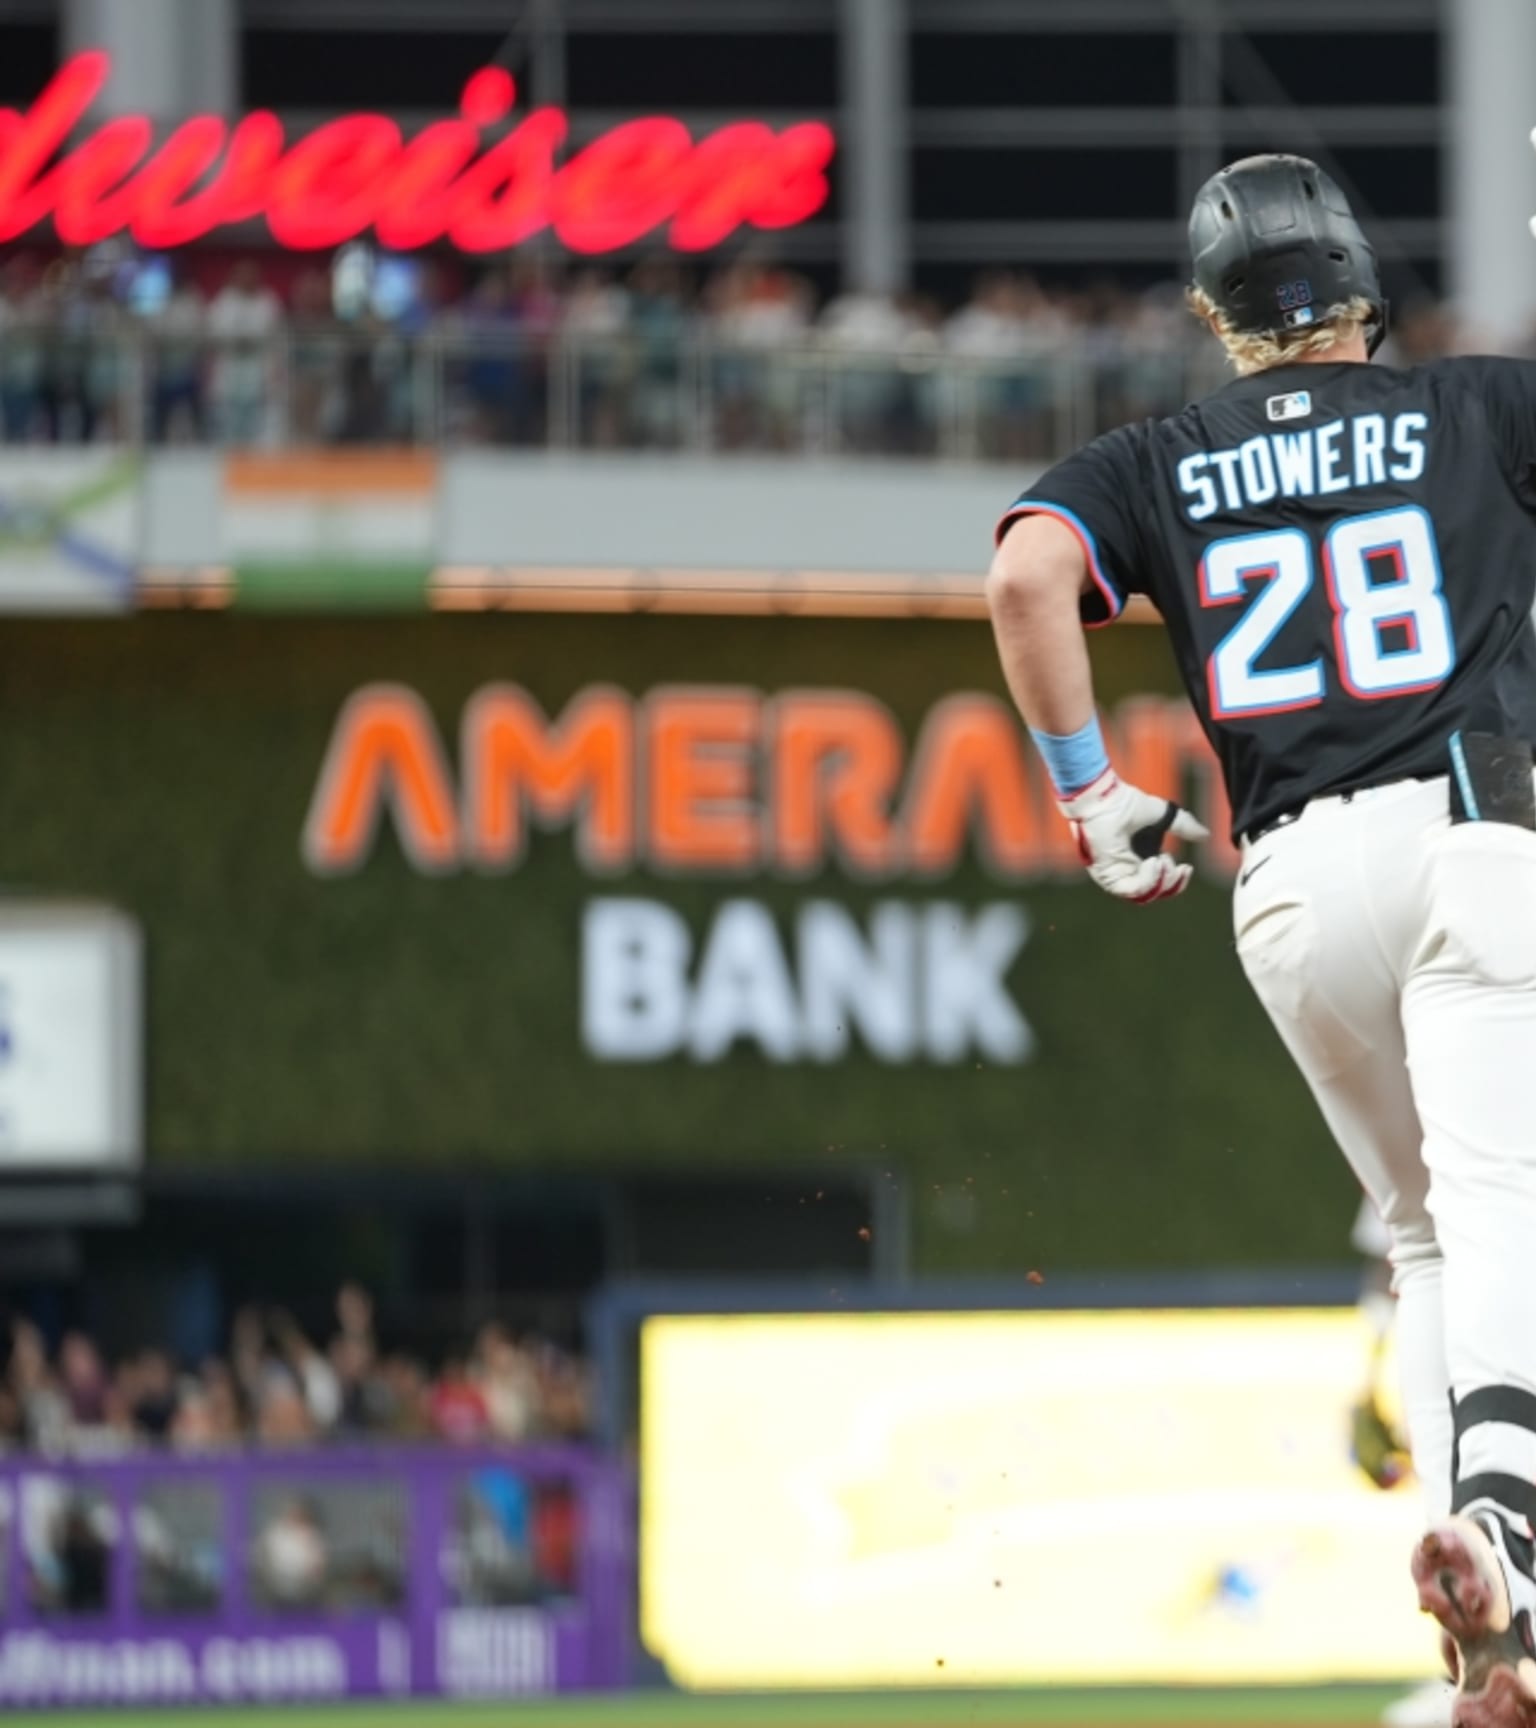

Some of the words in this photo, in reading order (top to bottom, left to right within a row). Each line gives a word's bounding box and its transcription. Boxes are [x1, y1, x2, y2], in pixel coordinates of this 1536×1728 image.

[1276, 280, 1312, 310] 28
[1177, 411, 1429, 521] STOWERS
[1198, 504, 1456, 721] 28
[580, 895, 1034, 1066] BANK
